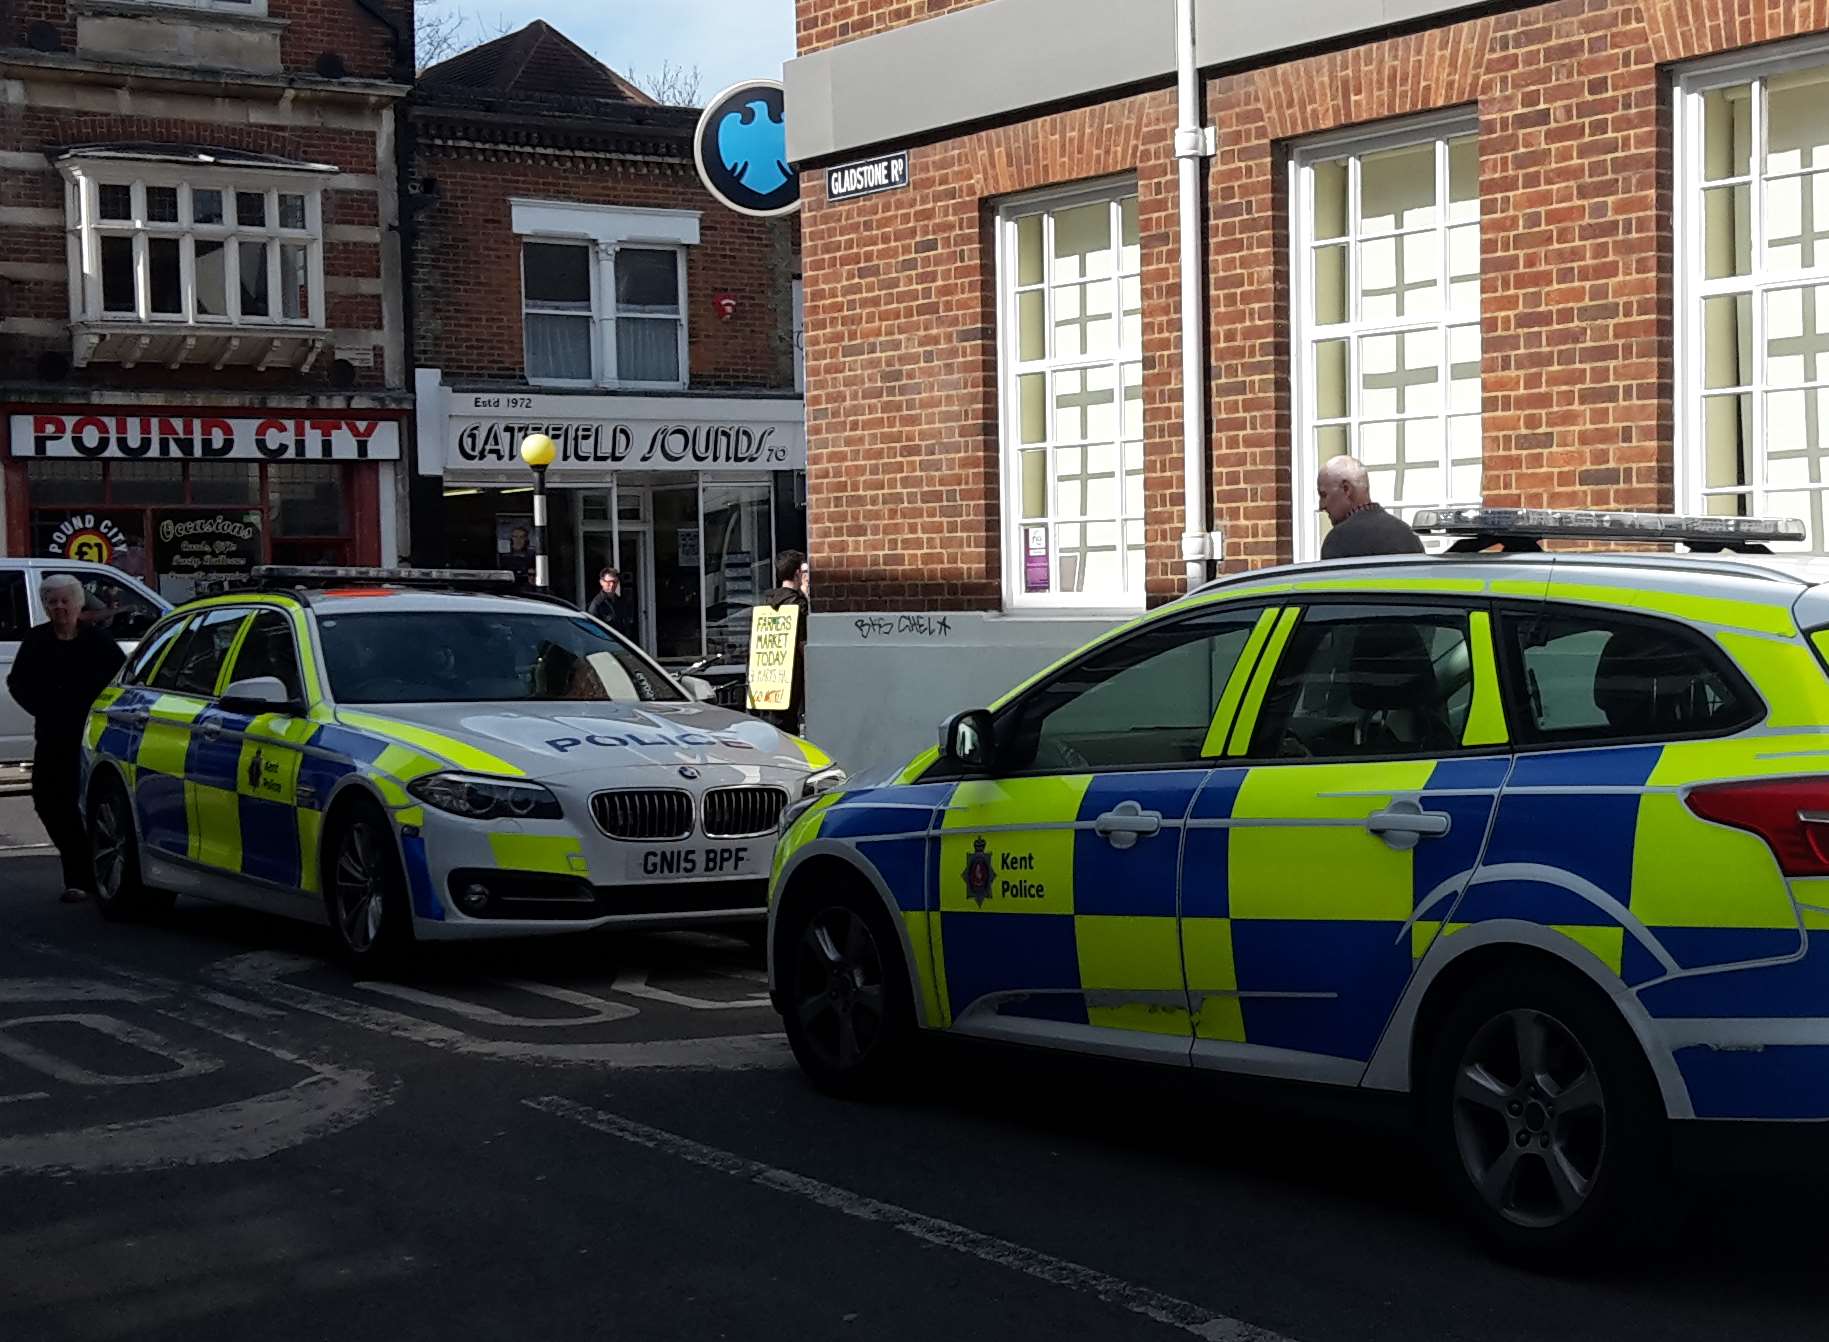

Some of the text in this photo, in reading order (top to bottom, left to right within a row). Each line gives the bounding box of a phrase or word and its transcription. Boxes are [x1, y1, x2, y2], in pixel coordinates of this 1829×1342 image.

[831, 161, 889, 195] GLADSTONE
[507, 397, 532, 409] 1972
[33, 414, 380, 459] POUND CITY
[640, 423, 776, 464] SOUNDS
[48, 513, 128, 554] POUND CITY
[160, 515, 253, 543] Occasions
[756, 615, 792, 633] FARMERS
[755, 632, 788, 649] MARKET
[755, 650, 788, 667] TODAY
[545, 732, 754, 753] POLICE
[642, 847, 749, 875] GN15 BPF
[1001, 852, 1034, 870] Kent
[1001, 879, 1045, 899] Police
